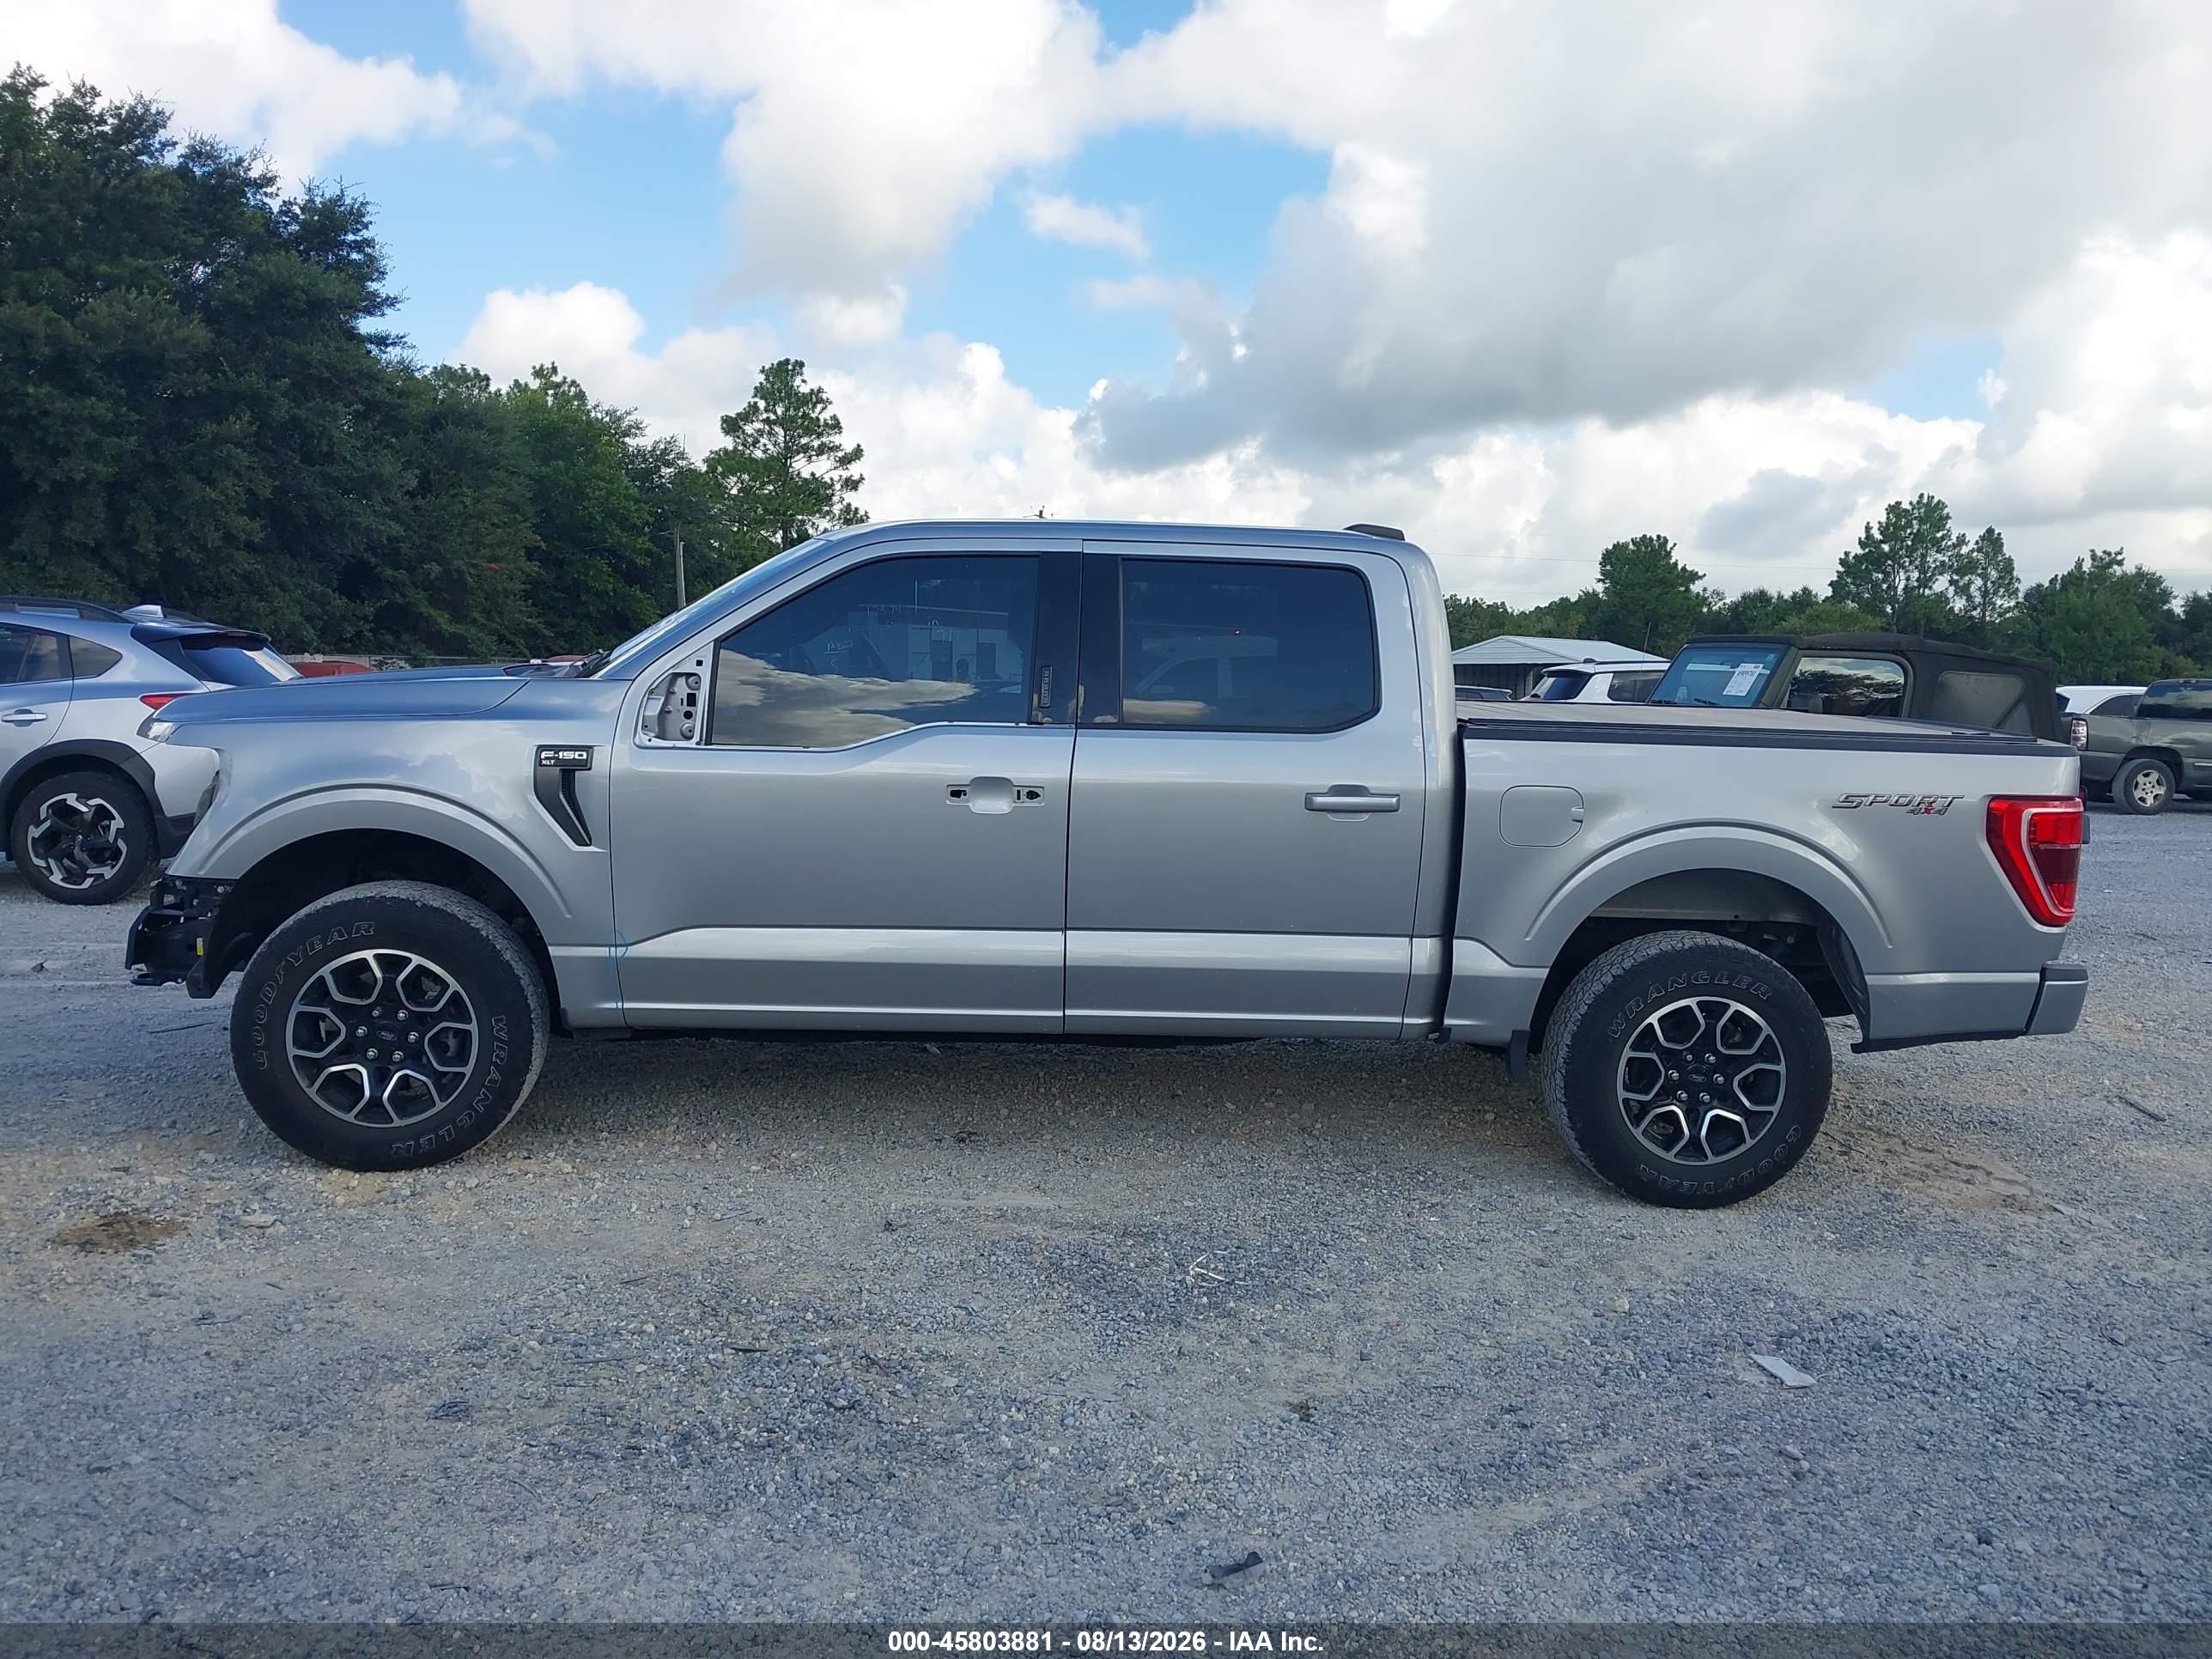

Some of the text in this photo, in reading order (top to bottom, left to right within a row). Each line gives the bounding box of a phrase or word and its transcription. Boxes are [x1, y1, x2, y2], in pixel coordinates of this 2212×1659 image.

[540, 750, 587, 760] F-150
[1831, 793, 1966, 809] SPORT
[252, 921, 375, 1070] GOODYEAR
[1607, 970, 1774, 1039] WRANGLER
[391, 1015, 508, 1158] WRANGLER
